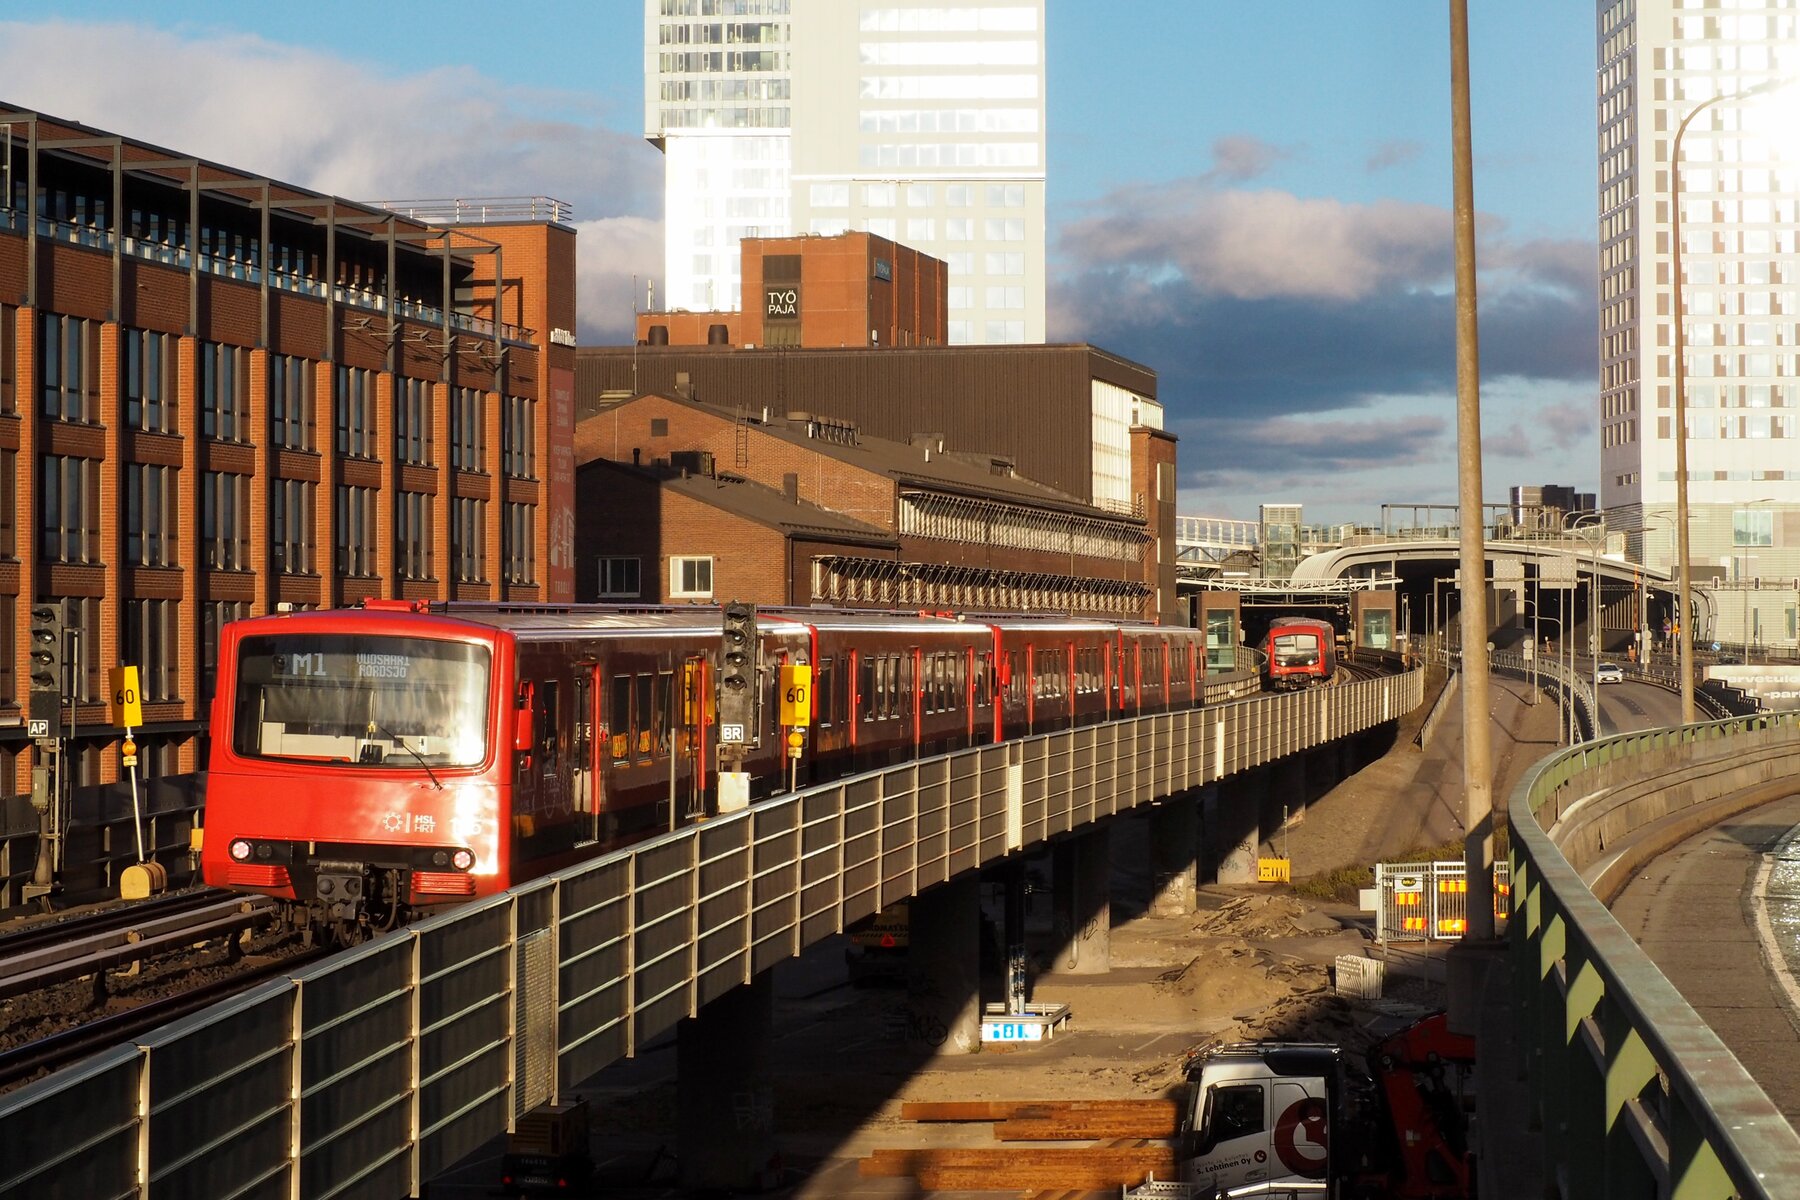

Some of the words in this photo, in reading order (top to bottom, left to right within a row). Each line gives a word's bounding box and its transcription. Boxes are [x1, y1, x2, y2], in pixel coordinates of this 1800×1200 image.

[768, 290, 797, 304] TYÖ
[768, 305, 796, 314] PAJA
[292, 653, 327, 676] M1
[356, 653, 410, 667] VUOSAARI
[116, 689, 135, 705] 60
[786, 688, 805, 703] 60
[30, 723, 46, 734] AP
[724, 727, 741, 740] BR
[414, 815, 436, 824] HSL
[414, 824, 435, 833] HRT
[1205, 1160, 1239, 1173] Lehtinen
